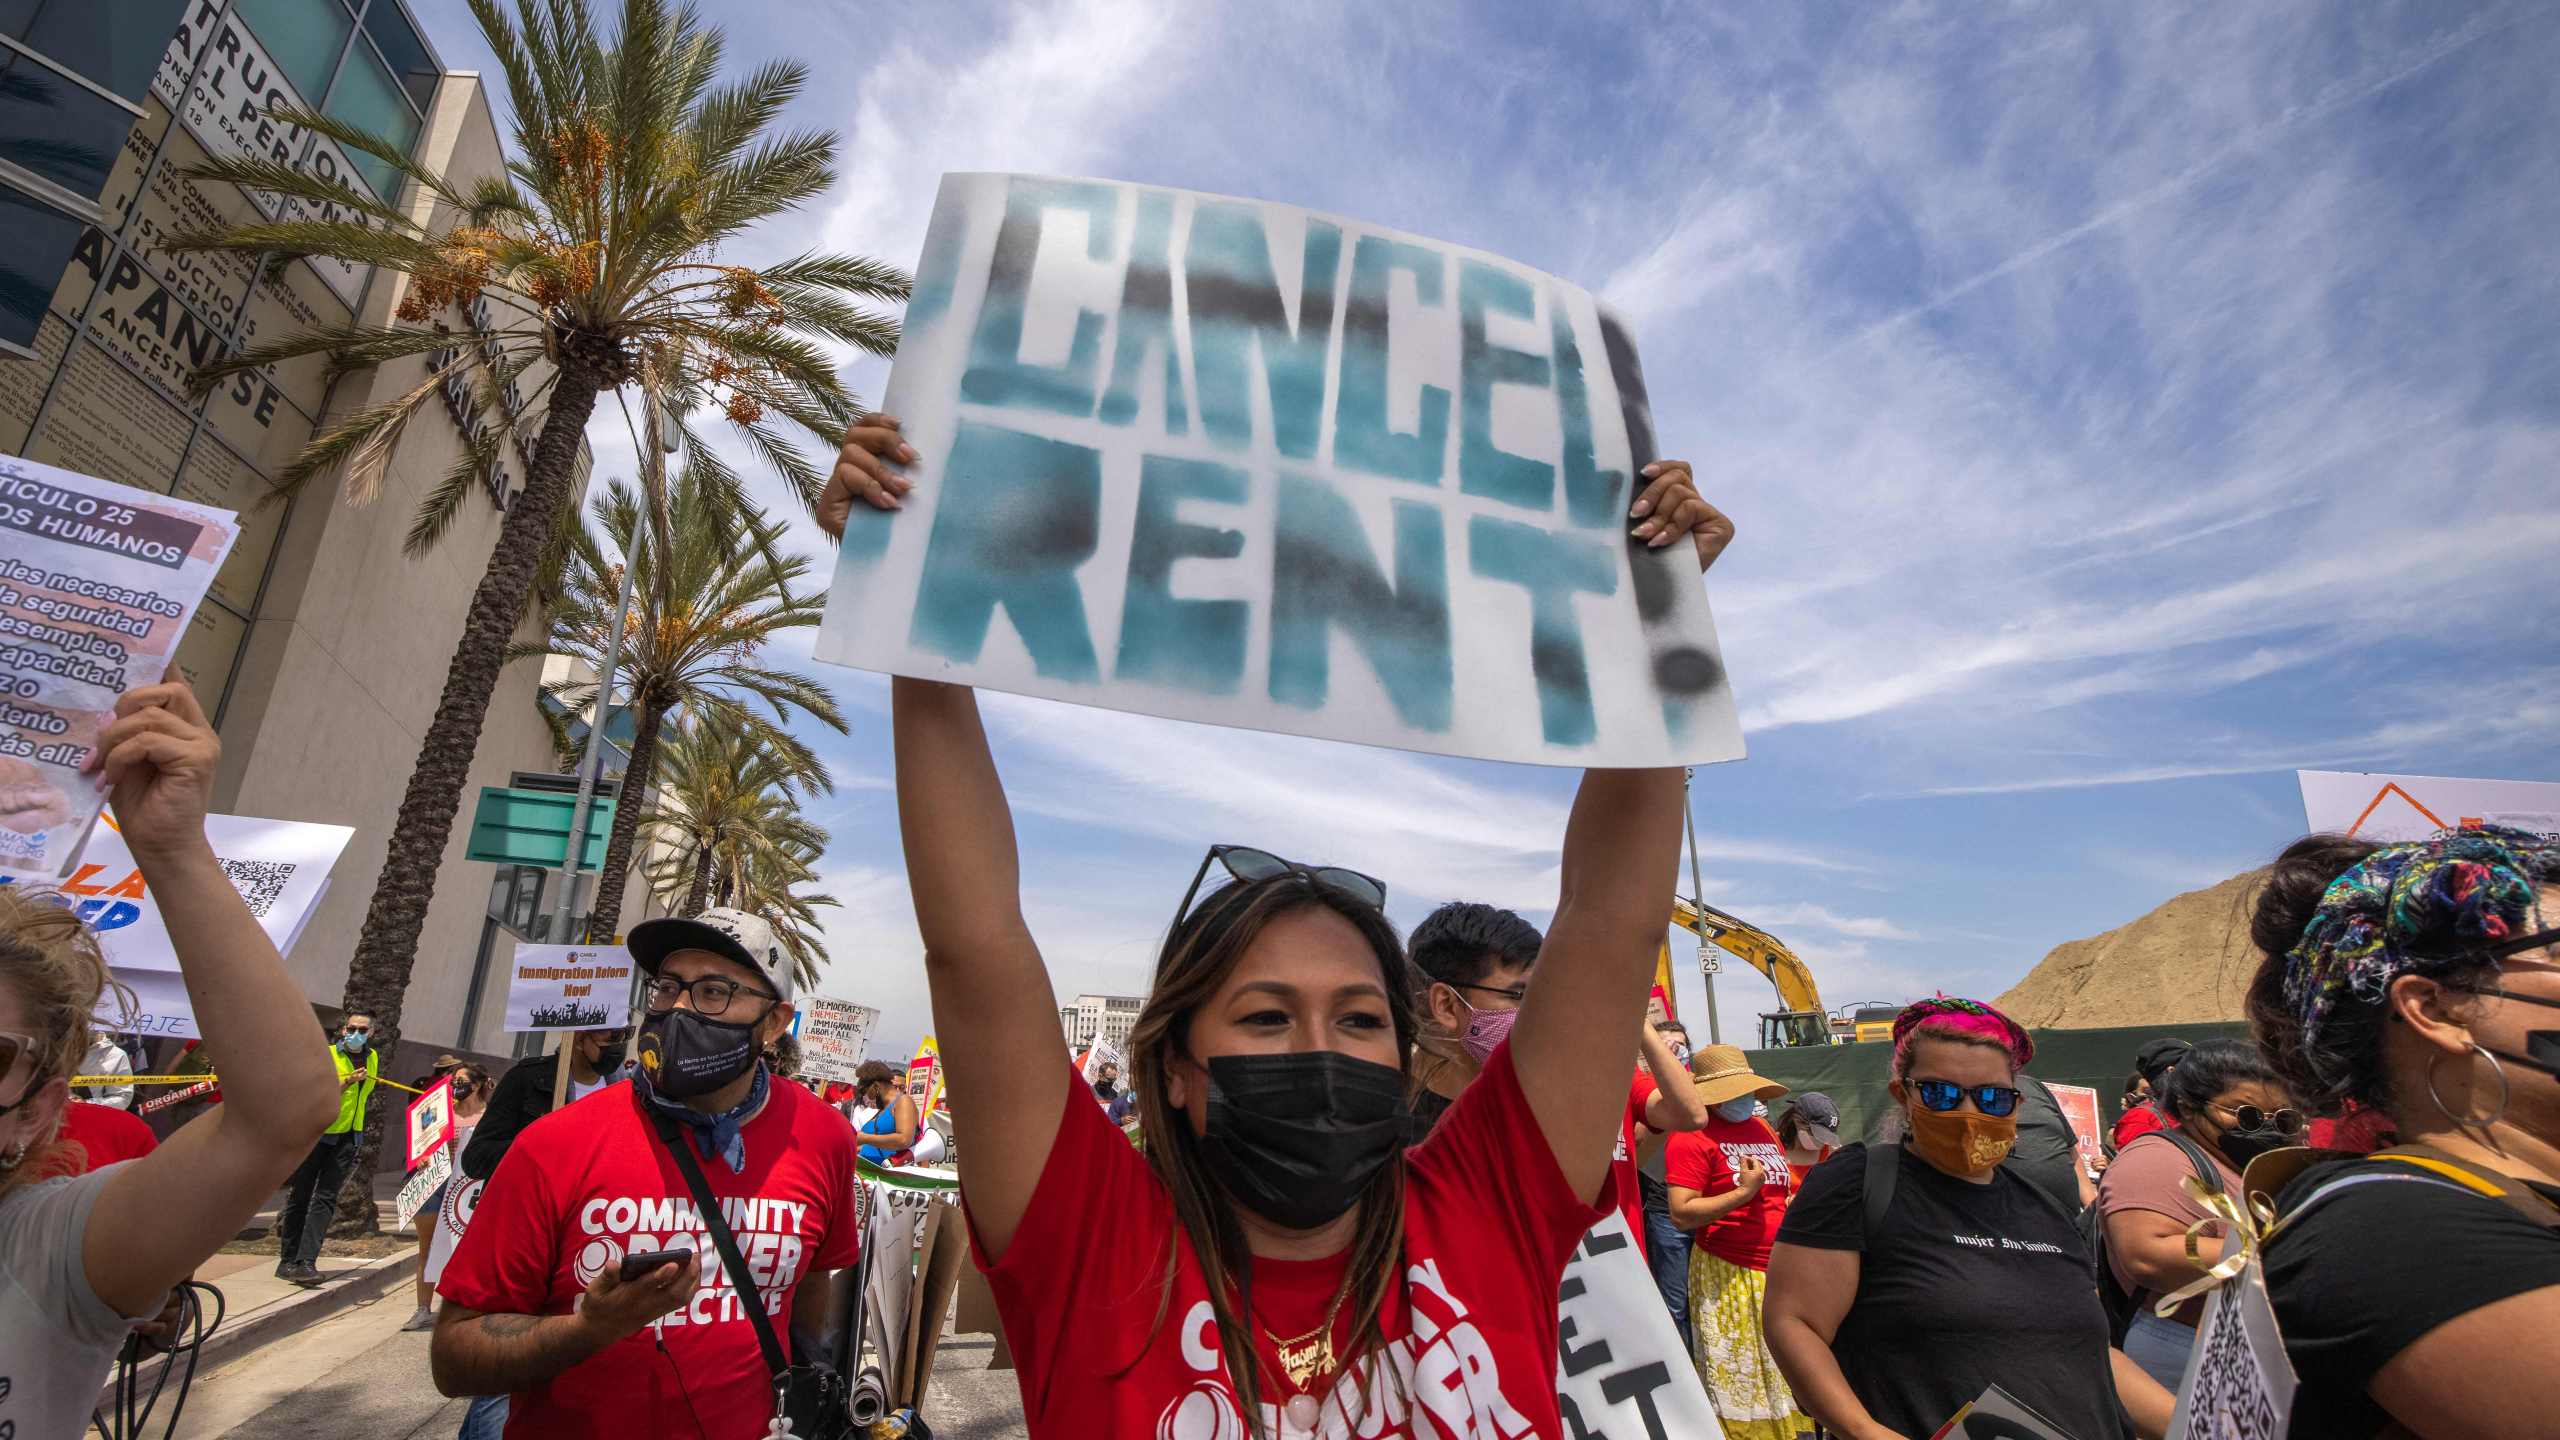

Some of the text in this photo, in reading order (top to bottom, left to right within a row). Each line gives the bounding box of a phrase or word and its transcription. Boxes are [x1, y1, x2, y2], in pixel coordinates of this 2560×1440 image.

[194, 86, 216, 115] ON
[188, 107, 203, 127] 18
[960, 176, 1624, 528] CANCEL
[101, 505, 137, 526] 25
[38, 515, 182, 564] HUMANOS
[48, 572, 182, 617] necesarios
[22, 594, 151, 638] seguridad
[17, 680, 39, 698] o
[58, 863, 146, 900] LA
[518, 966, 629, 980] Immigration Reform
[1702, 958, 1718, 971] 25
[563, 984, 592, 997] Now!
[848, 1014, 859, 1023] OF
[1953, 1234, 1995, 1248] mujer
